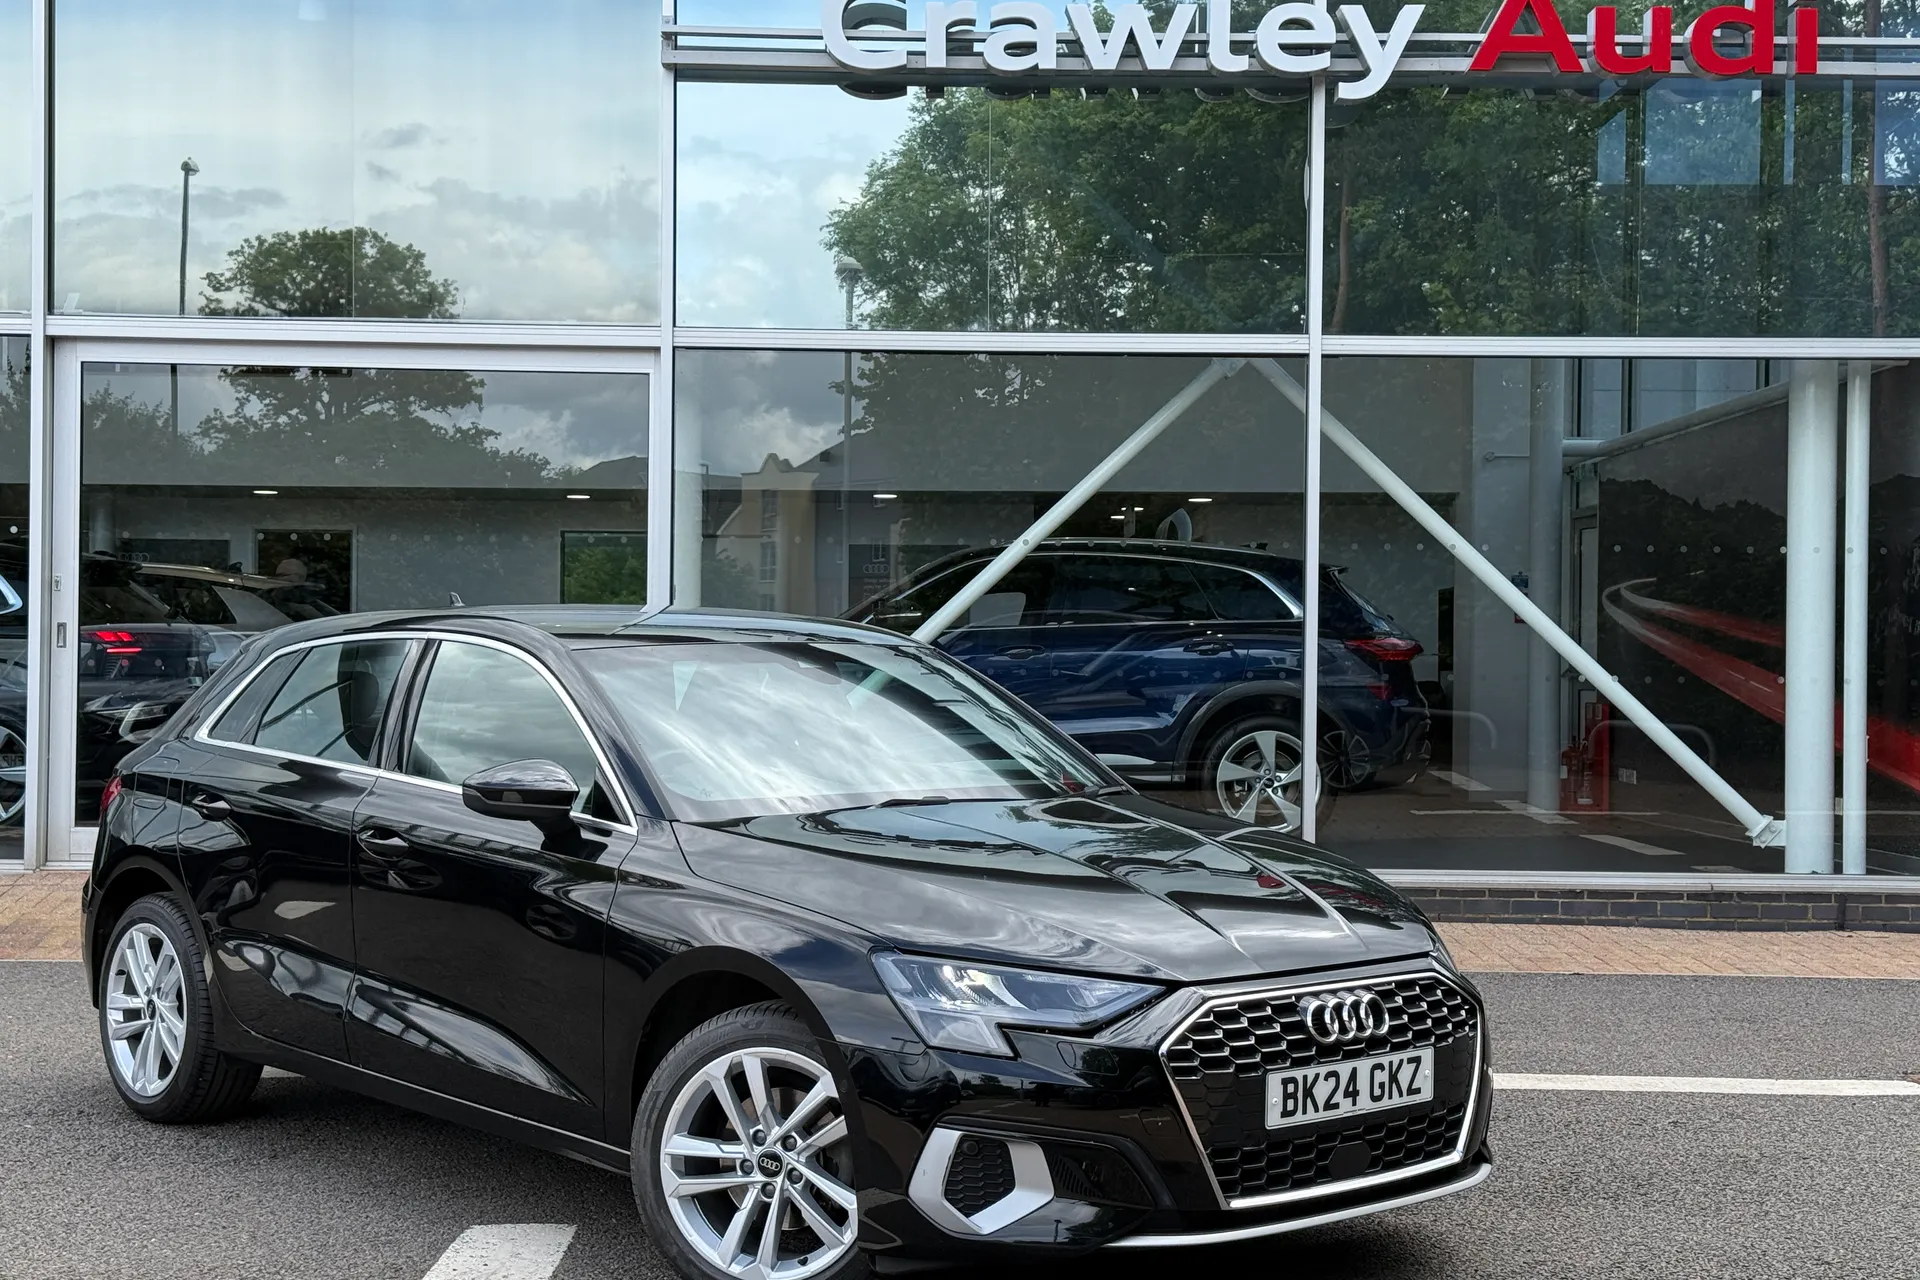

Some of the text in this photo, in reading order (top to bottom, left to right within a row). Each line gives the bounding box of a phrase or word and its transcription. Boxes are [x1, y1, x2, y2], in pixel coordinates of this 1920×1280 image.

[820, 0, 1818, 101] Crawley Audi
[1280, 1055, 1422, 1119] BK24 GKZ
